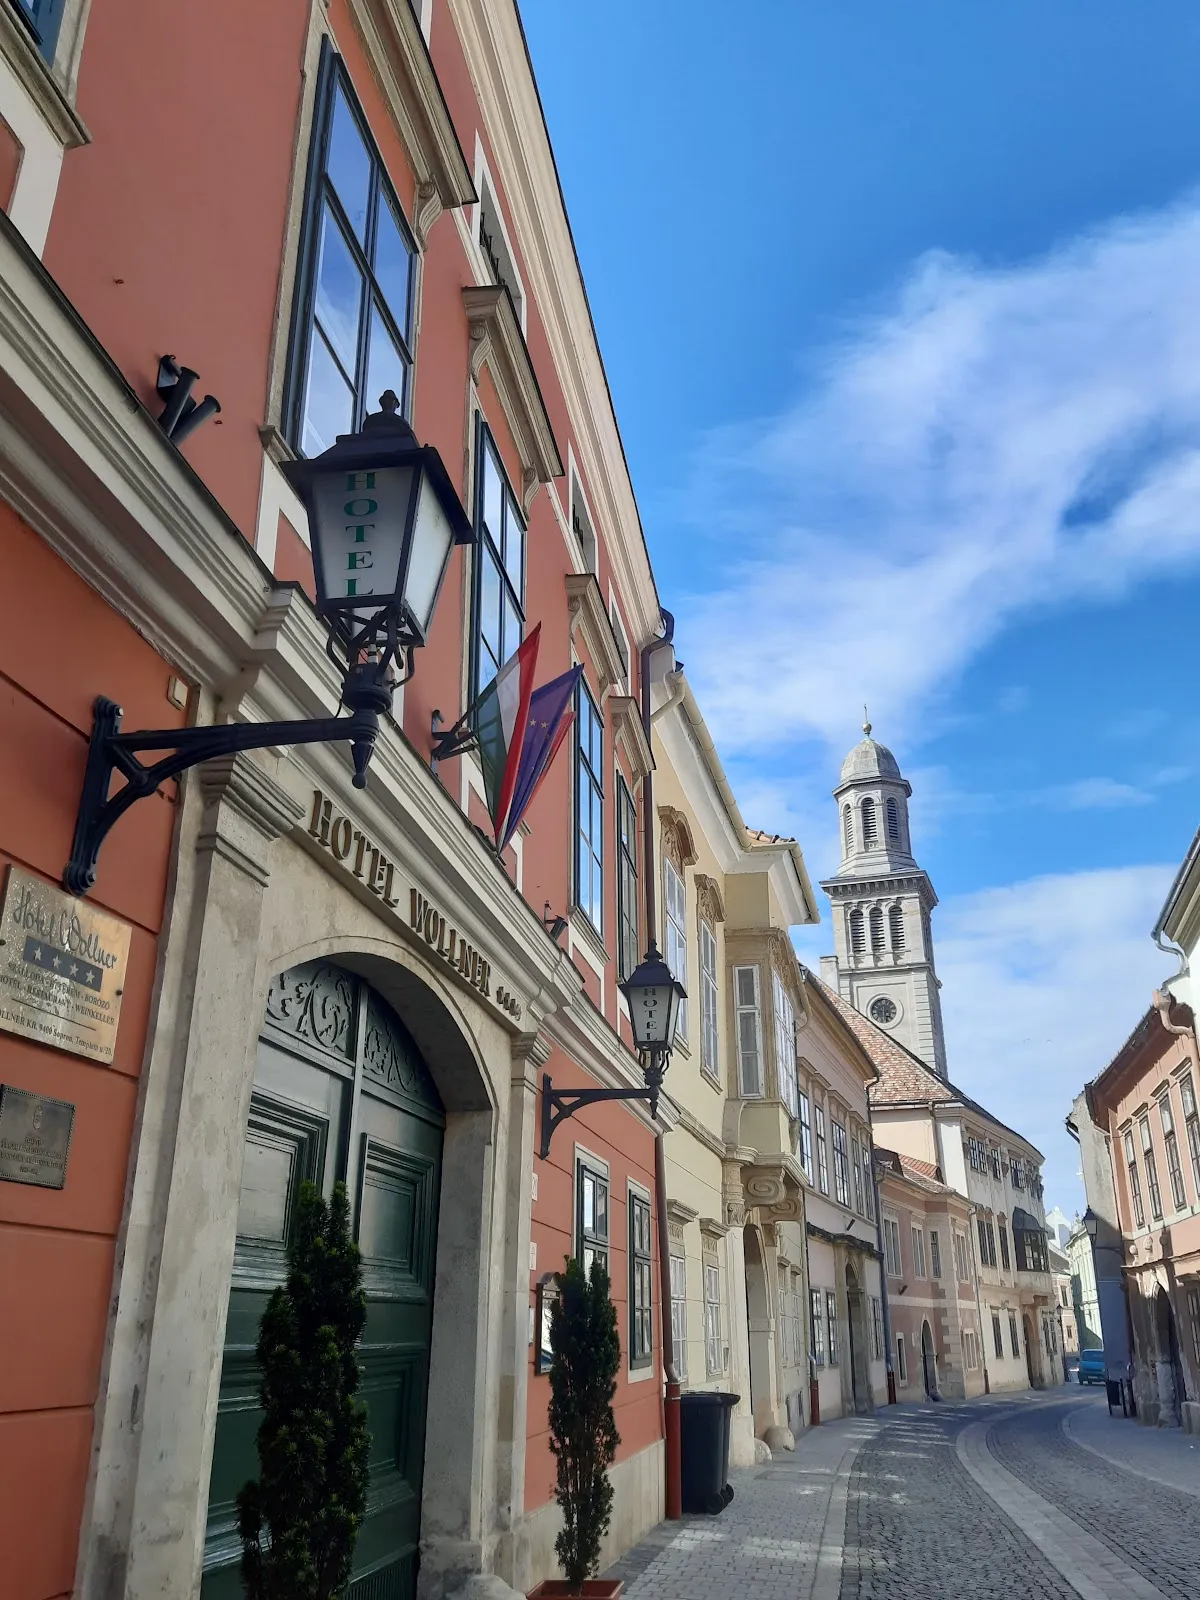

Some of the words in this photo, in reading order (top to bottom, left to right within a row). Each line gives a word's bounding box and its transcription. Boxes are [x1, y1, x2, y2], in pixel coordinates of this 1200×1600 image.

[343, 472, 378, 596] HOTEL
[308, 790, 400, 908] HOTEL
[410, 888, 490, 997] WOLLNER
[643, 988, 658, 1041] HOTEL
